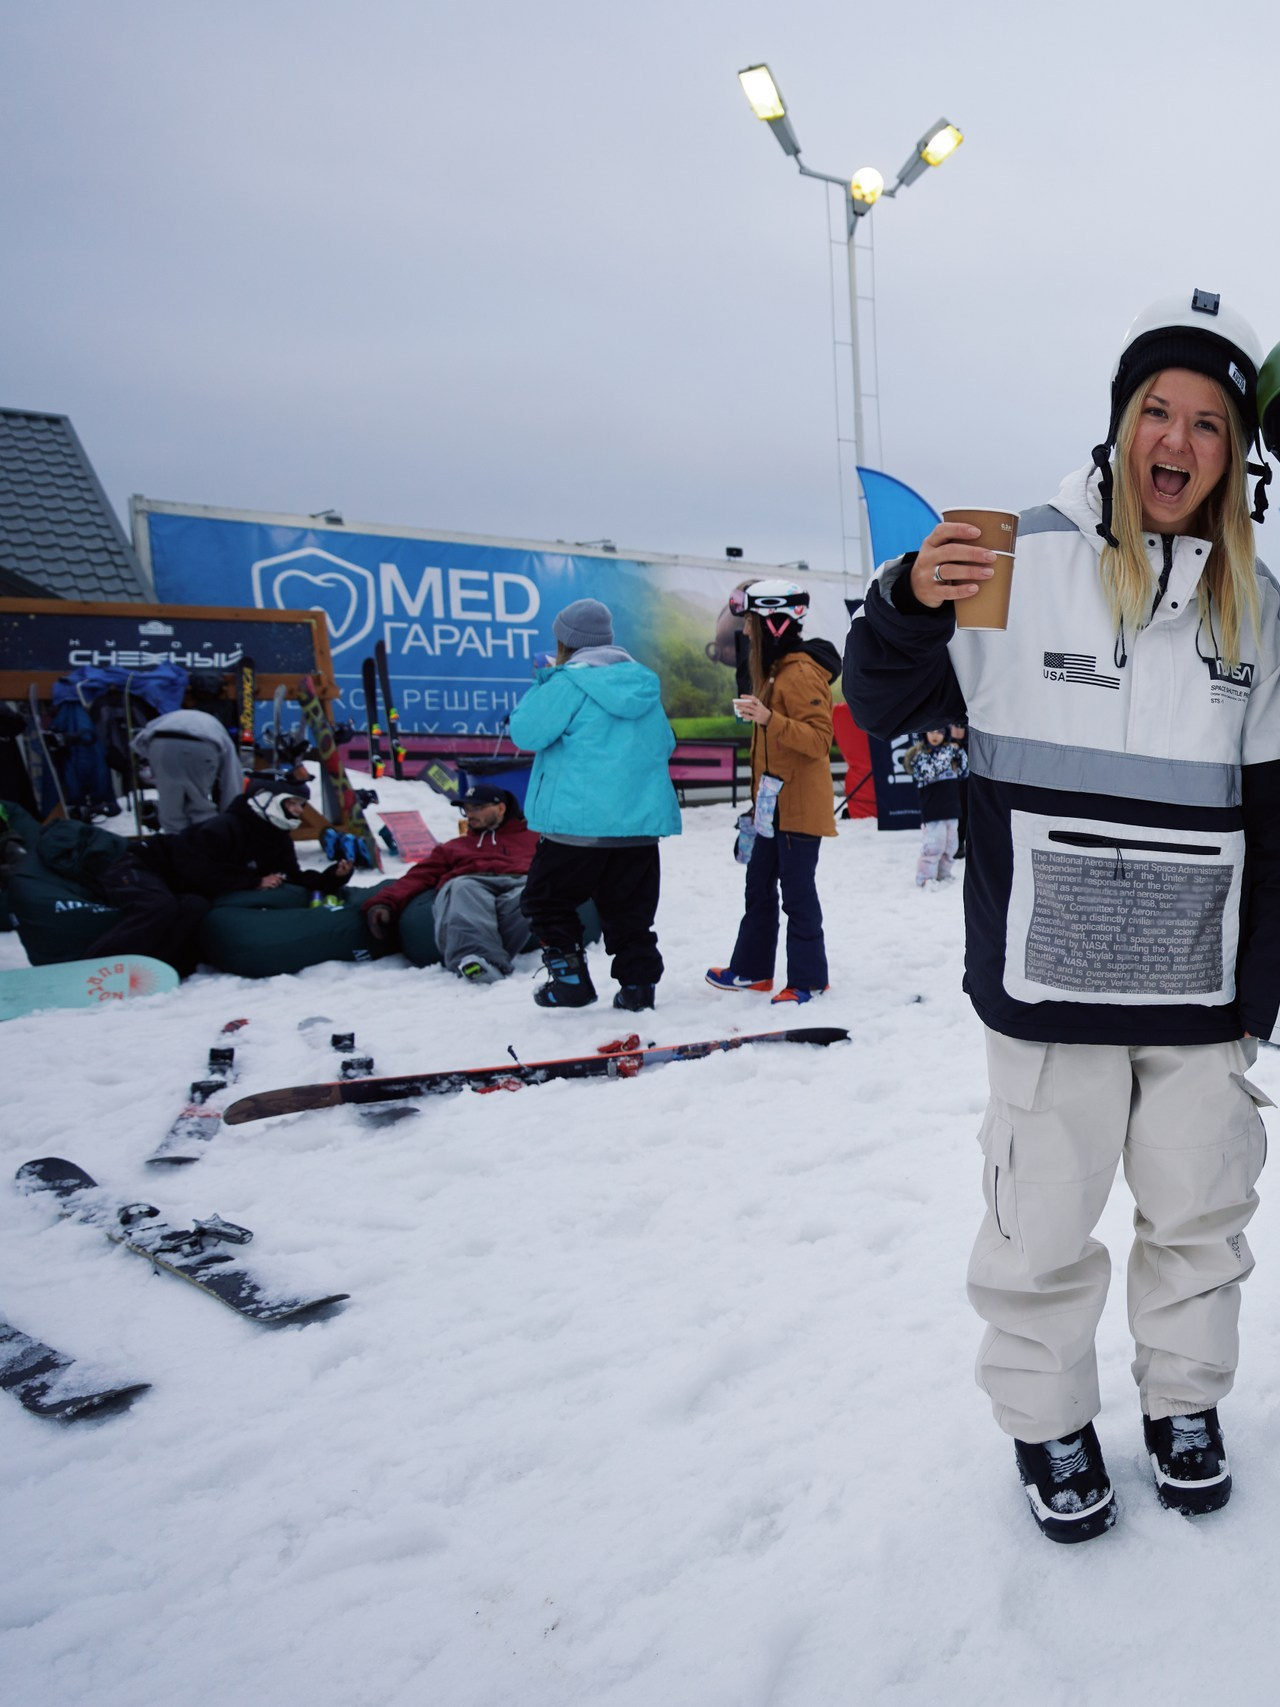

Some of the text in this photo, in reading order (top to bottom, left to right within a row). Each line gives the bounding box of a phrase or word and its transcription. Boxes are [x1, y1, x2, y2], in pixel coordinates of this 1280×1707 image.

[379, 563, 541, 623] MED
[384, 621, 539, 660] ГАРАНТ
[1043, 668, 1066, 682] USA
[1033, 852, 1048, 862] The
[1049, 854, 1083, 865] National
[1133, 863, 1149, 871] and
[1151, 863, 1177, 873] Space
[1033, 862, 1082, 874] independent
[1089, 868, 1115, 878] agenc
[1125, 871, 1134, 879] of
[1141, 871, 1155, 880] the
[1161, 873, 1187, 882] United
[1034, 870, 1082, 883] Government
[1133, 881, 1144, 889] for
[1147, 881, 1161, 890] the
[1060, 884, 1070, 892] as
[1119, 889, 1135, 897] and
[1057, 894, 1074, 902] was
[1069, 903, 1114, 913] Committee
[1117, 906, 1128, 914] for
[1035, 907, 1051, 916] was
[1089, 913, 1126, 925] distinctly
[1071, 923, 1121, 933] applications
[1030, 932, 1051, 943] been
[1054, 936, 1066, 946] led
[1069, 940, 1078, 950] by
[1152, 945, 1166, 954] the
[1091, 933, 1113, 942] most
[1130, 935, 1155, 946] space
[1071, 949, 1084, 958] the
[1085, 950, 1114, 961] Skylab
[1173, 954, 1189, 963] and
[1063, 957, 1089, 968] NASA
[1093, 961, 1101, 969] is
[1155, 963, 1168, 971] the
[1057, 965, 1073, 974] and
[1133, 971, 1147, 980] the
[1149, 971, 1197, 981] development
[1084, 978, 1108, 987] Crew
[1143, 979, 1157, 988] the
[1159, 980, 1184, 989] Space
